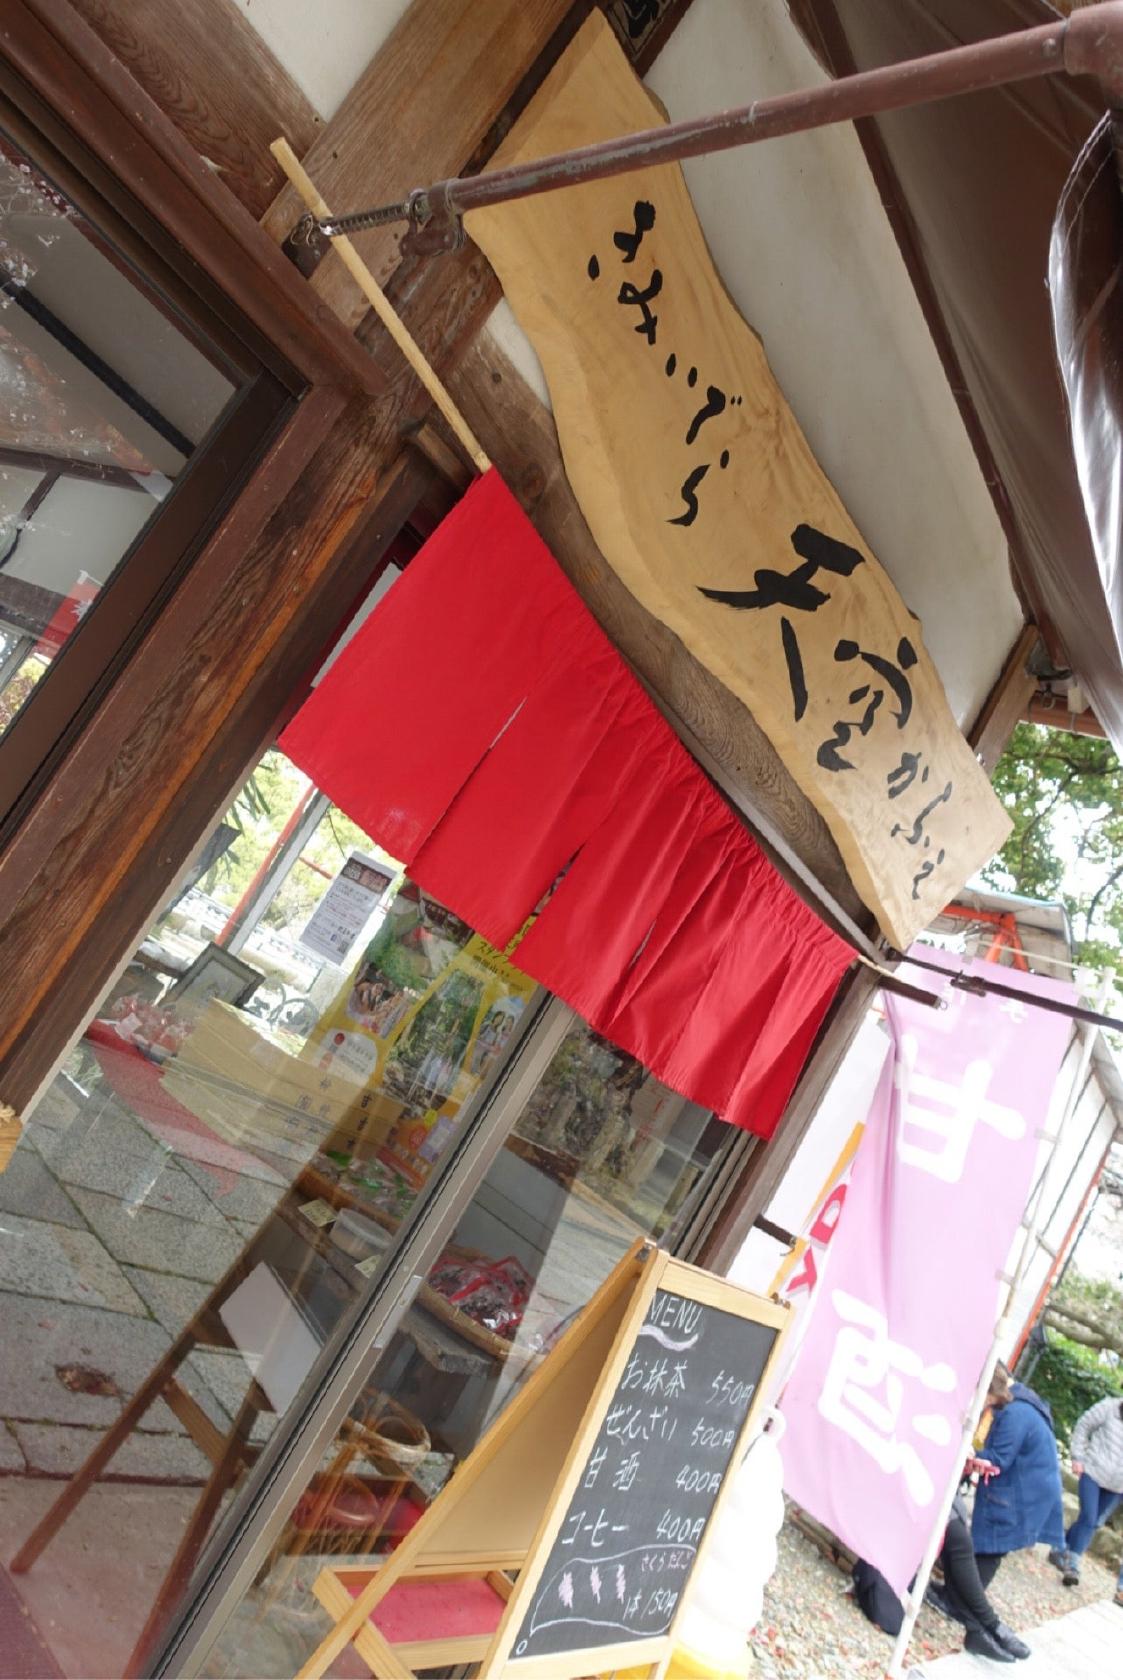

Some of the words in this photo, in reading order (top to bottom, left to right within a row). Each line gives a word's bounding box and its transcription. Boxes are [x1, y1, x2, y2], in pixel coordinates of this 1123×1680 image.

[650, 1294, 704, 1334] MENU
[621, 1353, 688, 1399] お抹茶
[705, 1370, 754, 1408] 550円
[606, 1404, 678, 1445] ぜんざい
[690, 1417, 735, 1449] 500円
[676, 1465, 723, 1495] 400円
[562, 1509, 629, 1547] コーヒー
[656, 1509, 706, 1543] 400円
